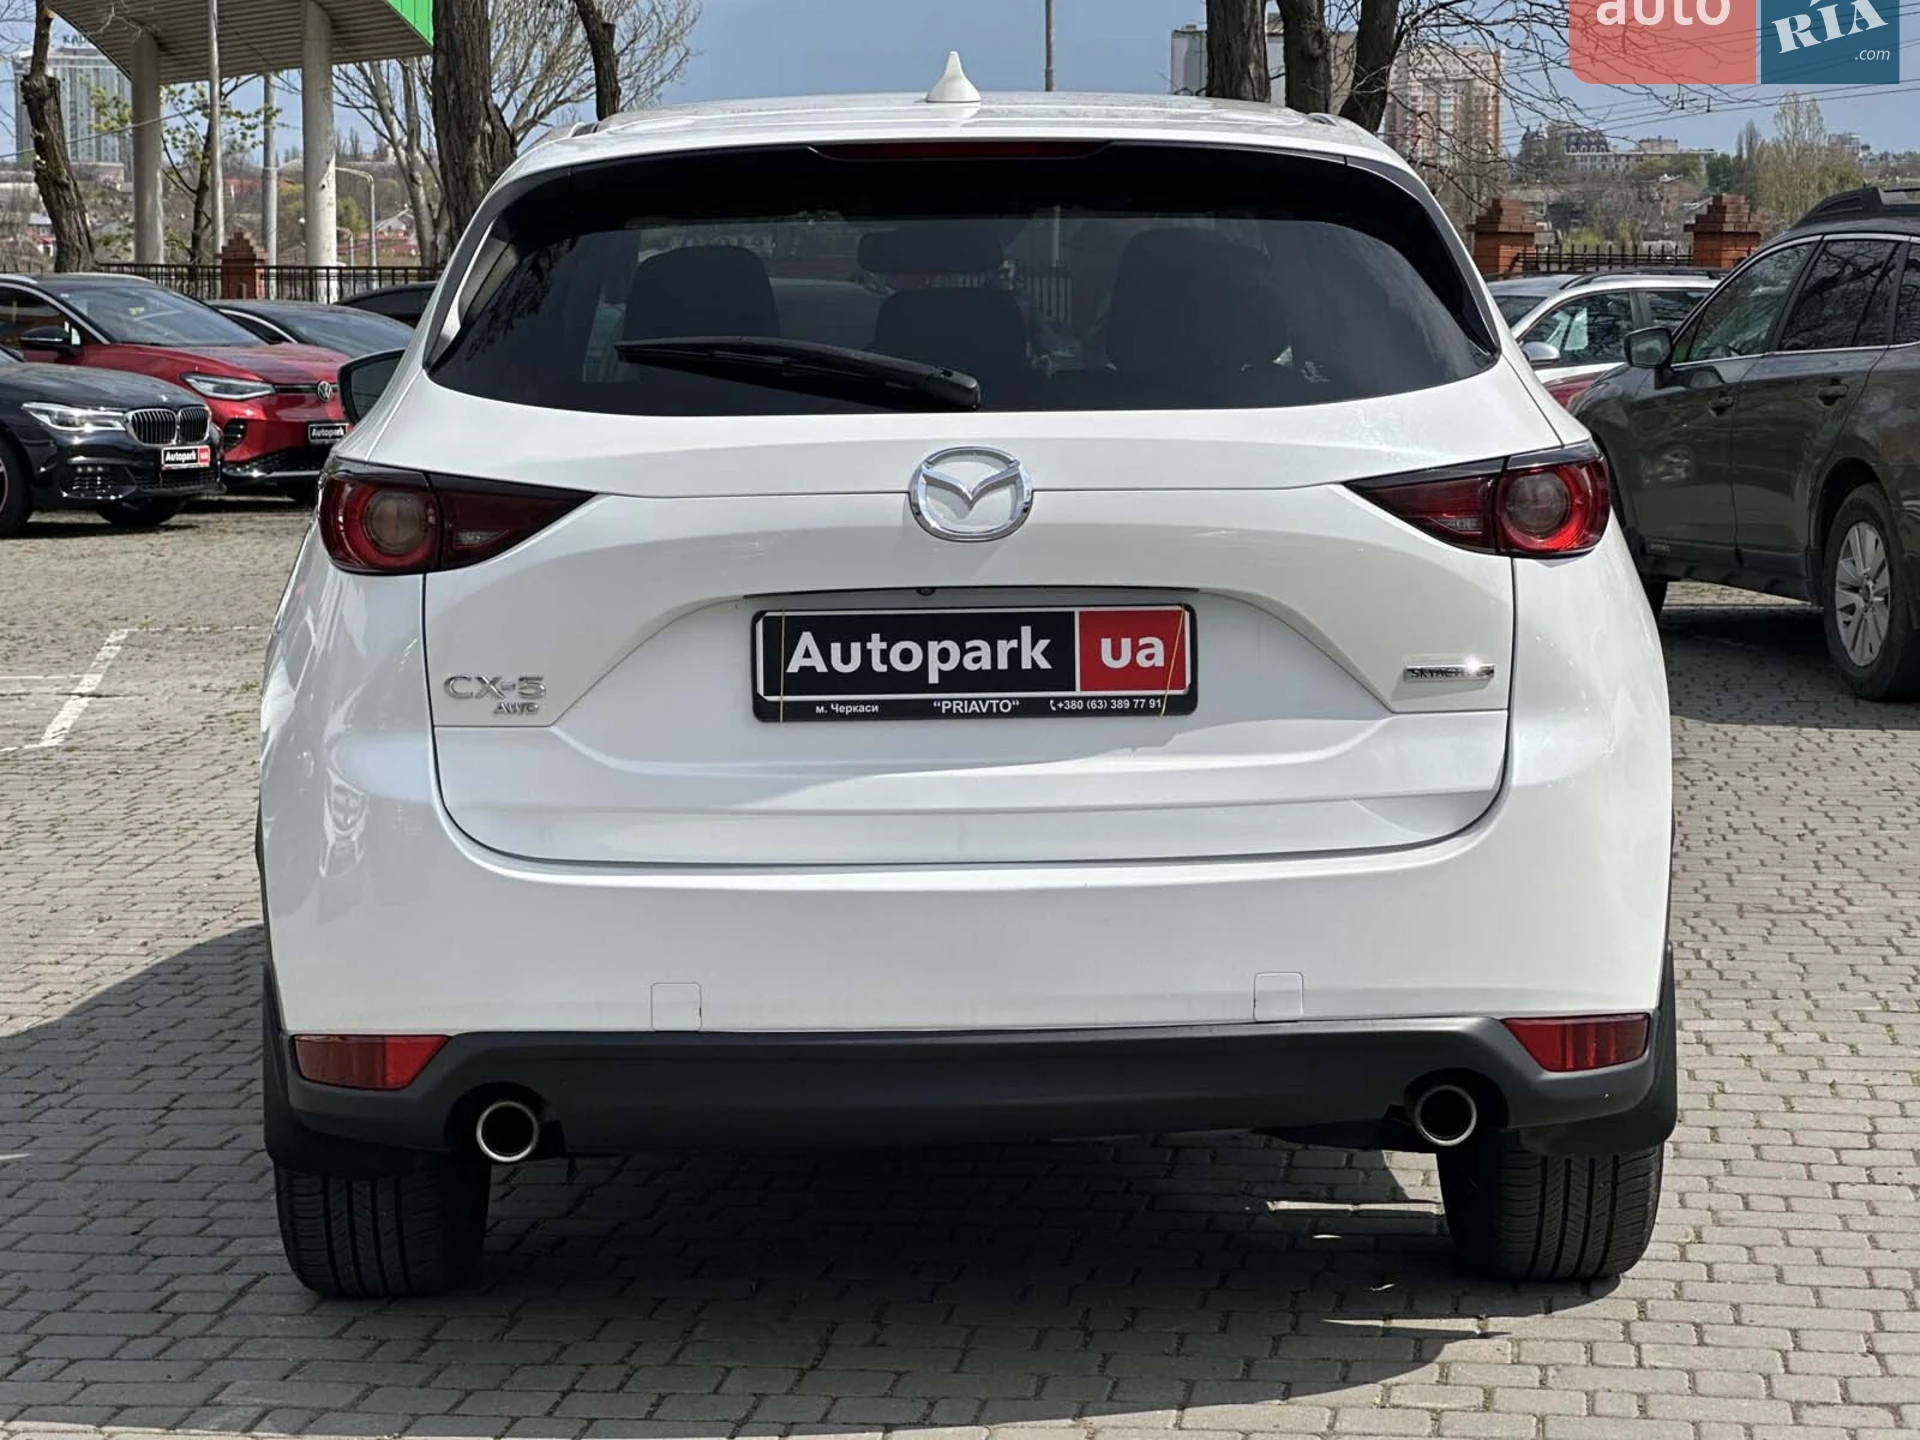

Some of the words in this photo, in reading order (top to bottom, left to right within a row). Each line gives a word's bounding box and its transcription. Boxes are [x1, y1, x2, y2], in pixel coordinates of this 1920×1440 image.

[165, 450, 197, 463] Autopark
[785, 625, 1053, 685] Autopark
[1100, 634, 1165, 670] ua
[443, 675, 546, 699] CX-5
[830, 703, 880, 715] Черкаси
[1057, 700, 1084, 710] +380
[1086, 699, 1108, 711] (63)
[1110, 699, 1130, 709] 389
[1133, 699, 1146, 709] 77
[1149, 698, 1162, 709] 91
